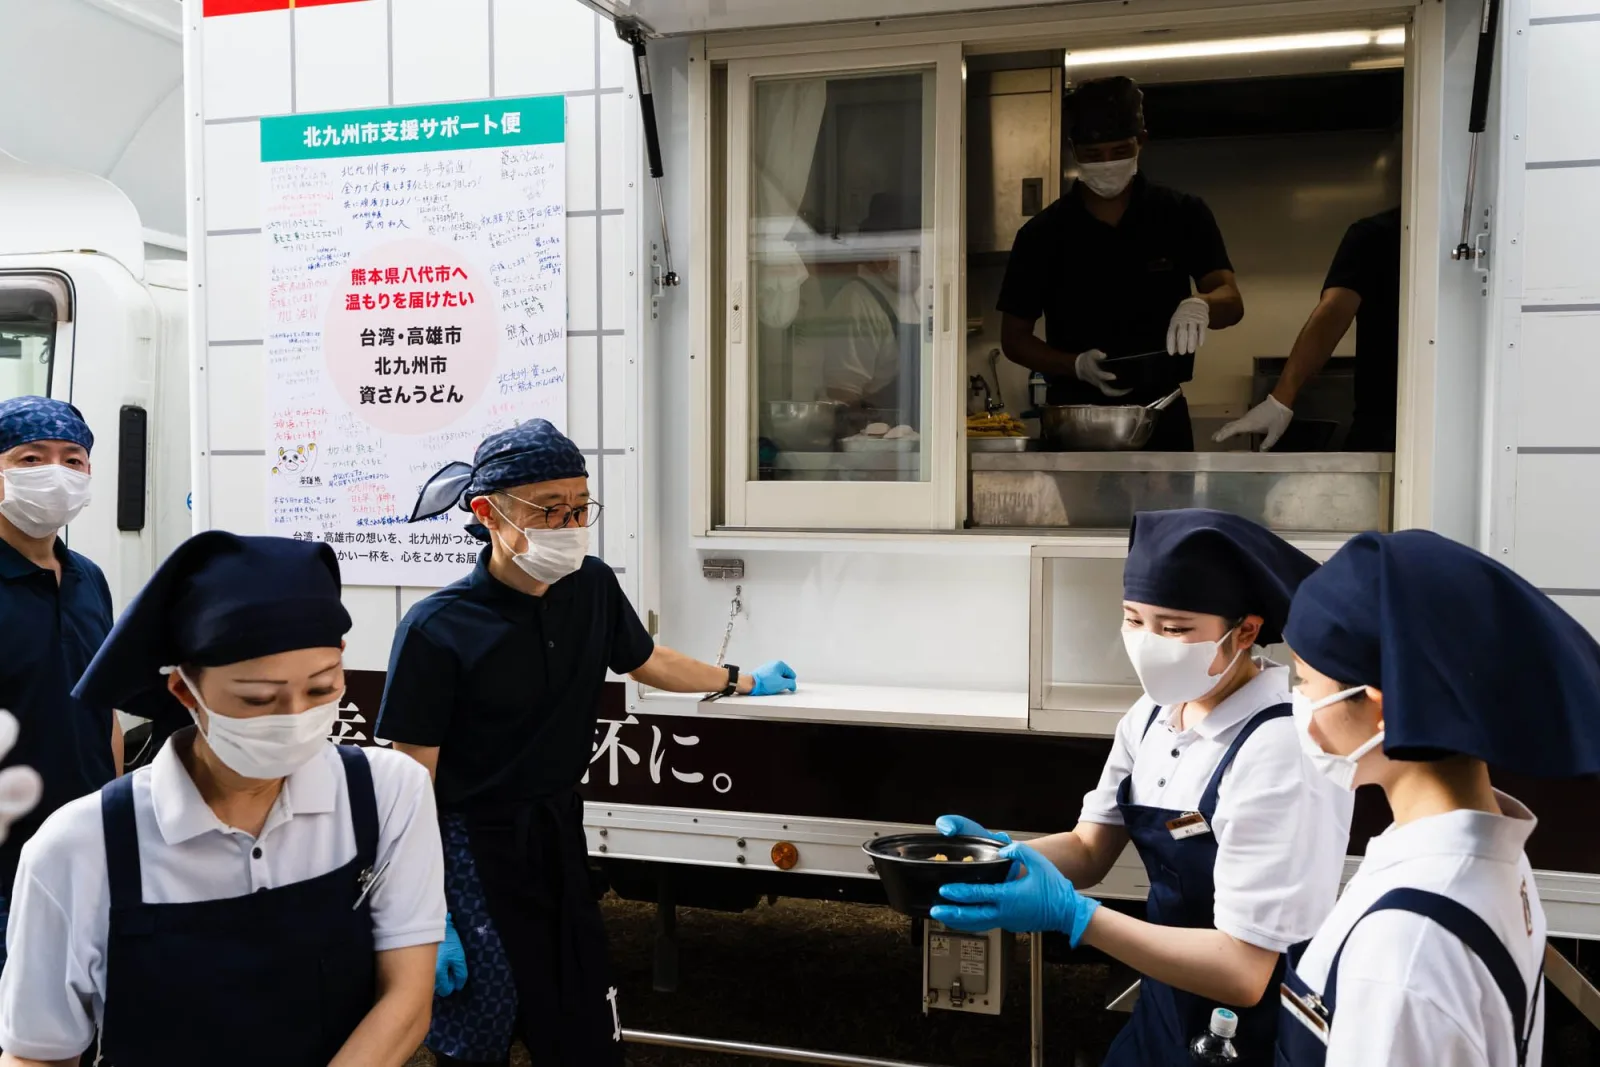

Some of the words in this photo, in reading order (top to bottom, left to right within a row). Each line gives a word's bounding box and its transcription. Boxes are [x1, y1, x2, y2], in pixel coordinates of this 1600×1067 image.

[303, 111, 522, 148] 北九州市支援サポート便
[351, 265, 468, 286] 熊本県八代市へ
[345, 290, 475, 311] 温もりを届けたい
[360, 326, 462, 347] 台湾・高雄市
[374, 355, 447, 375] 北九州市
[359, 385, 464, 405] 資さんうどん
